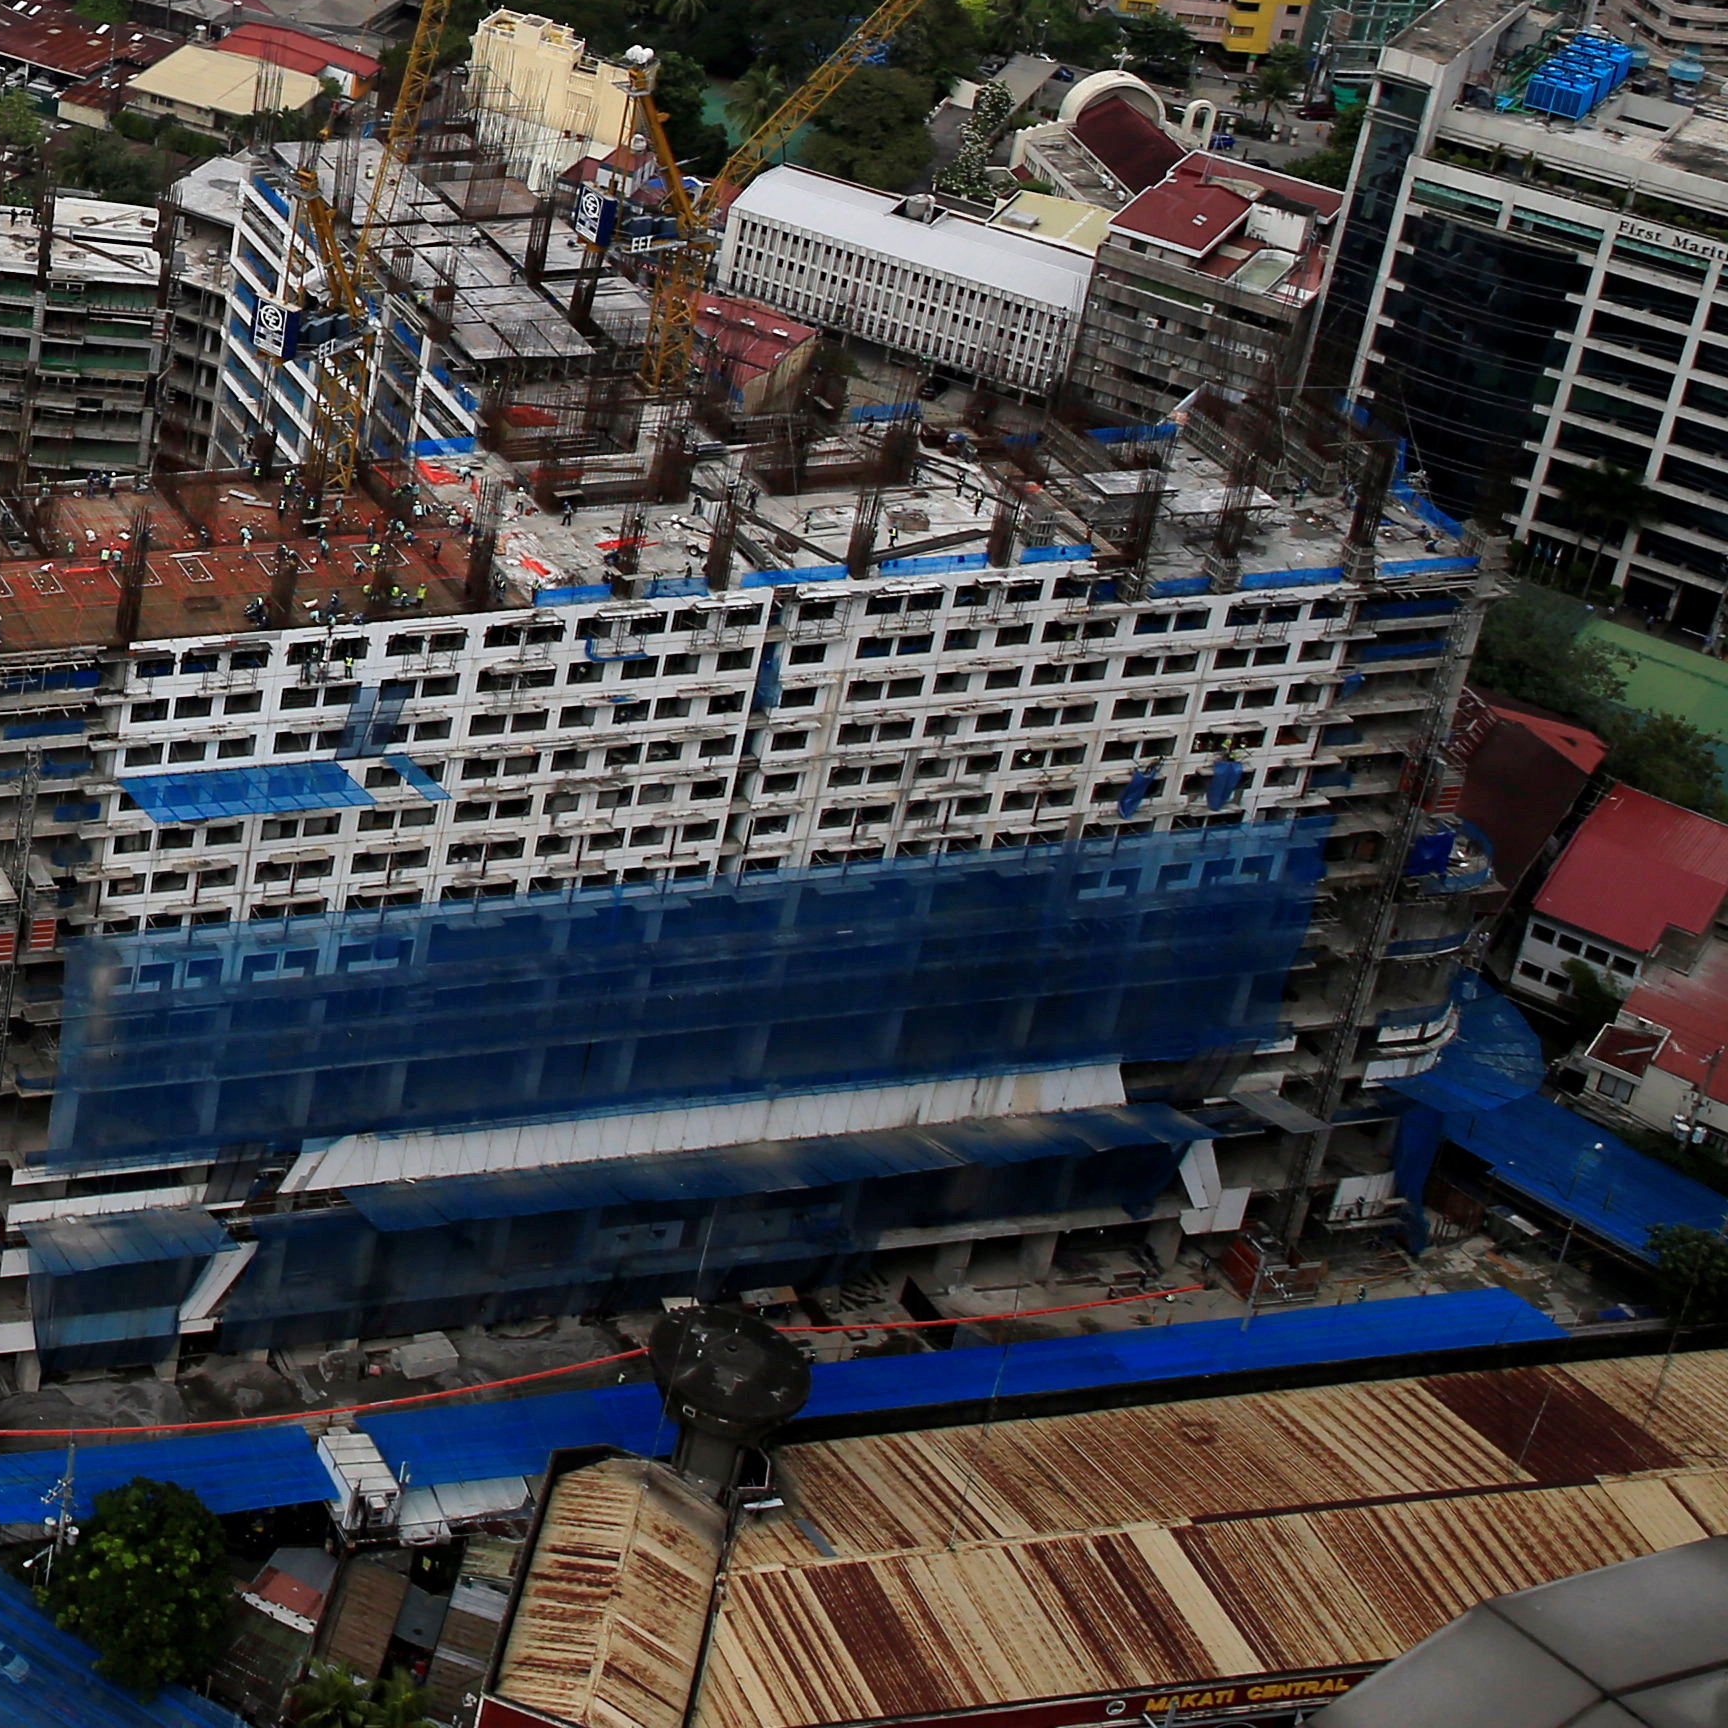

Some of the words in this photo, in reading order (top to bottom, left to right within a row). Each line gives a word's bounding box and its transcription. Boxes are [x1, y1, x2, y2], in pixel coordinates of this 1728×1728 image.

[1618, 220, 1662, 242] First
[1144, 1689, 1235, 1713] MAKATI
[1247, 1678, 1350, 1700] CENTRAL
